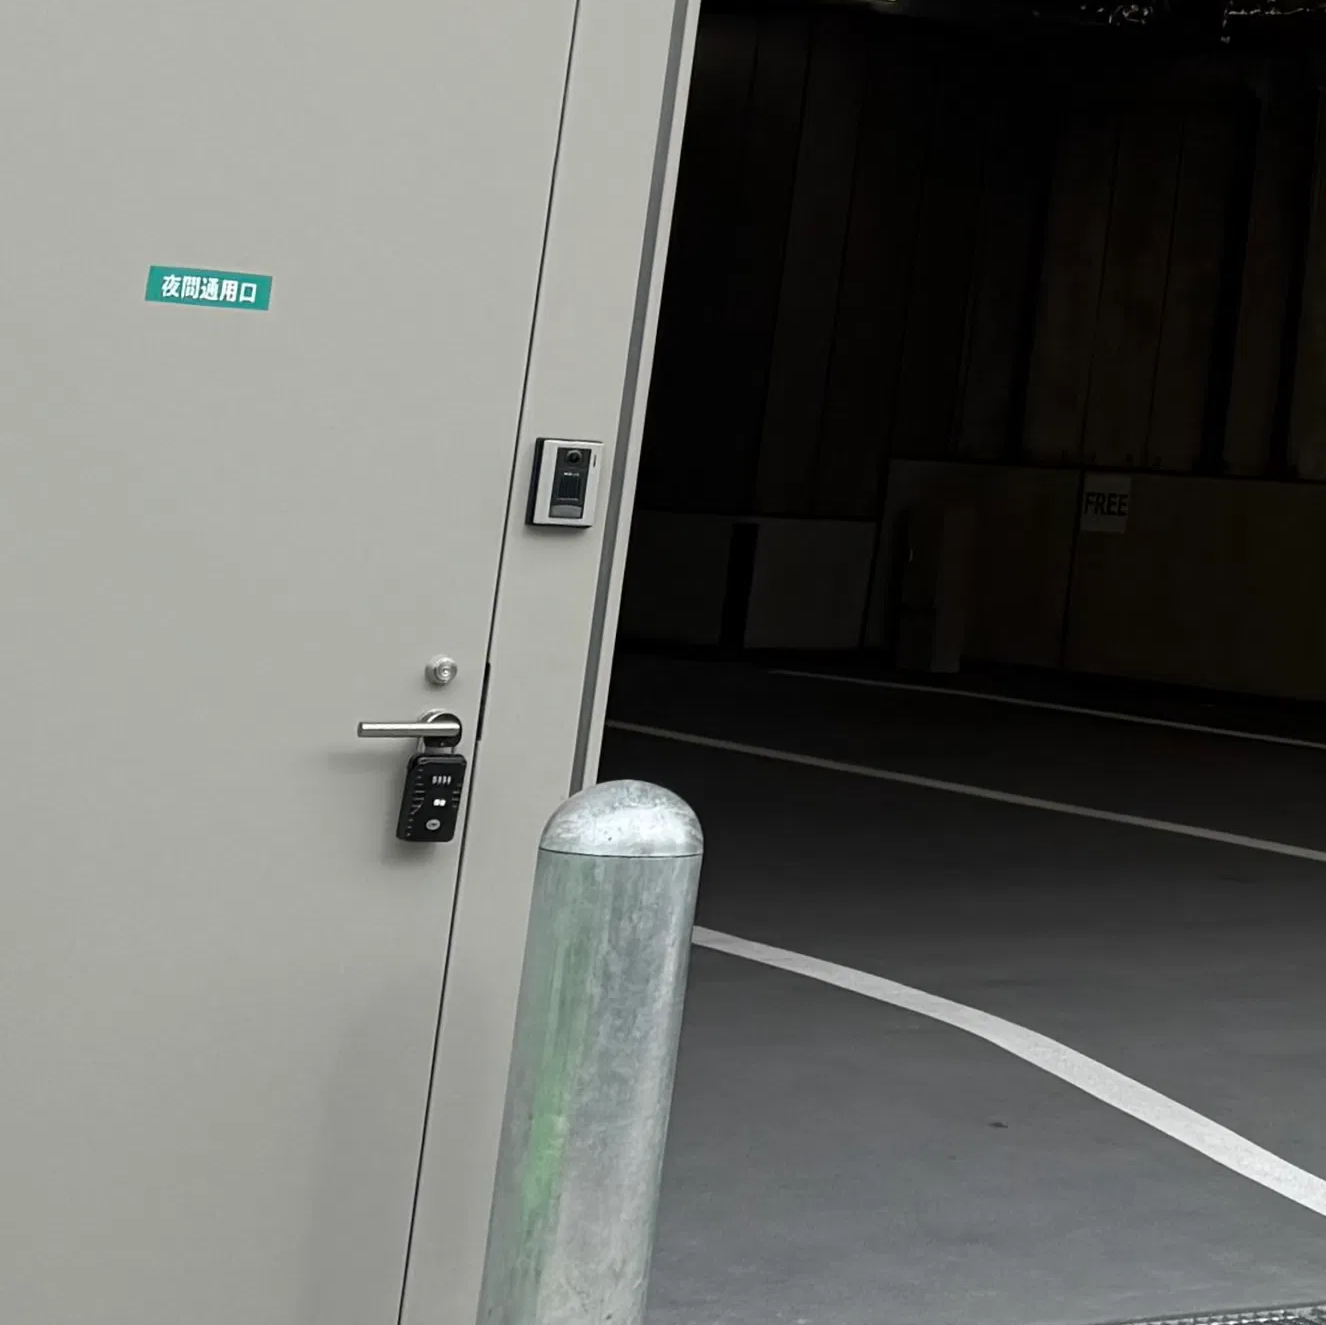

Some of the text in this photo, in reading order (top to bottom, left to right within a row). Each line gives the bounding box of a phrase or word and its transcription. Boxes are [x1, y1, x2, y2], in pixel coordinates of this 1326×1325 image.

[161, 274, 257, 303] 夜間通用口
[1083, 492, 1129, 516] FREE
